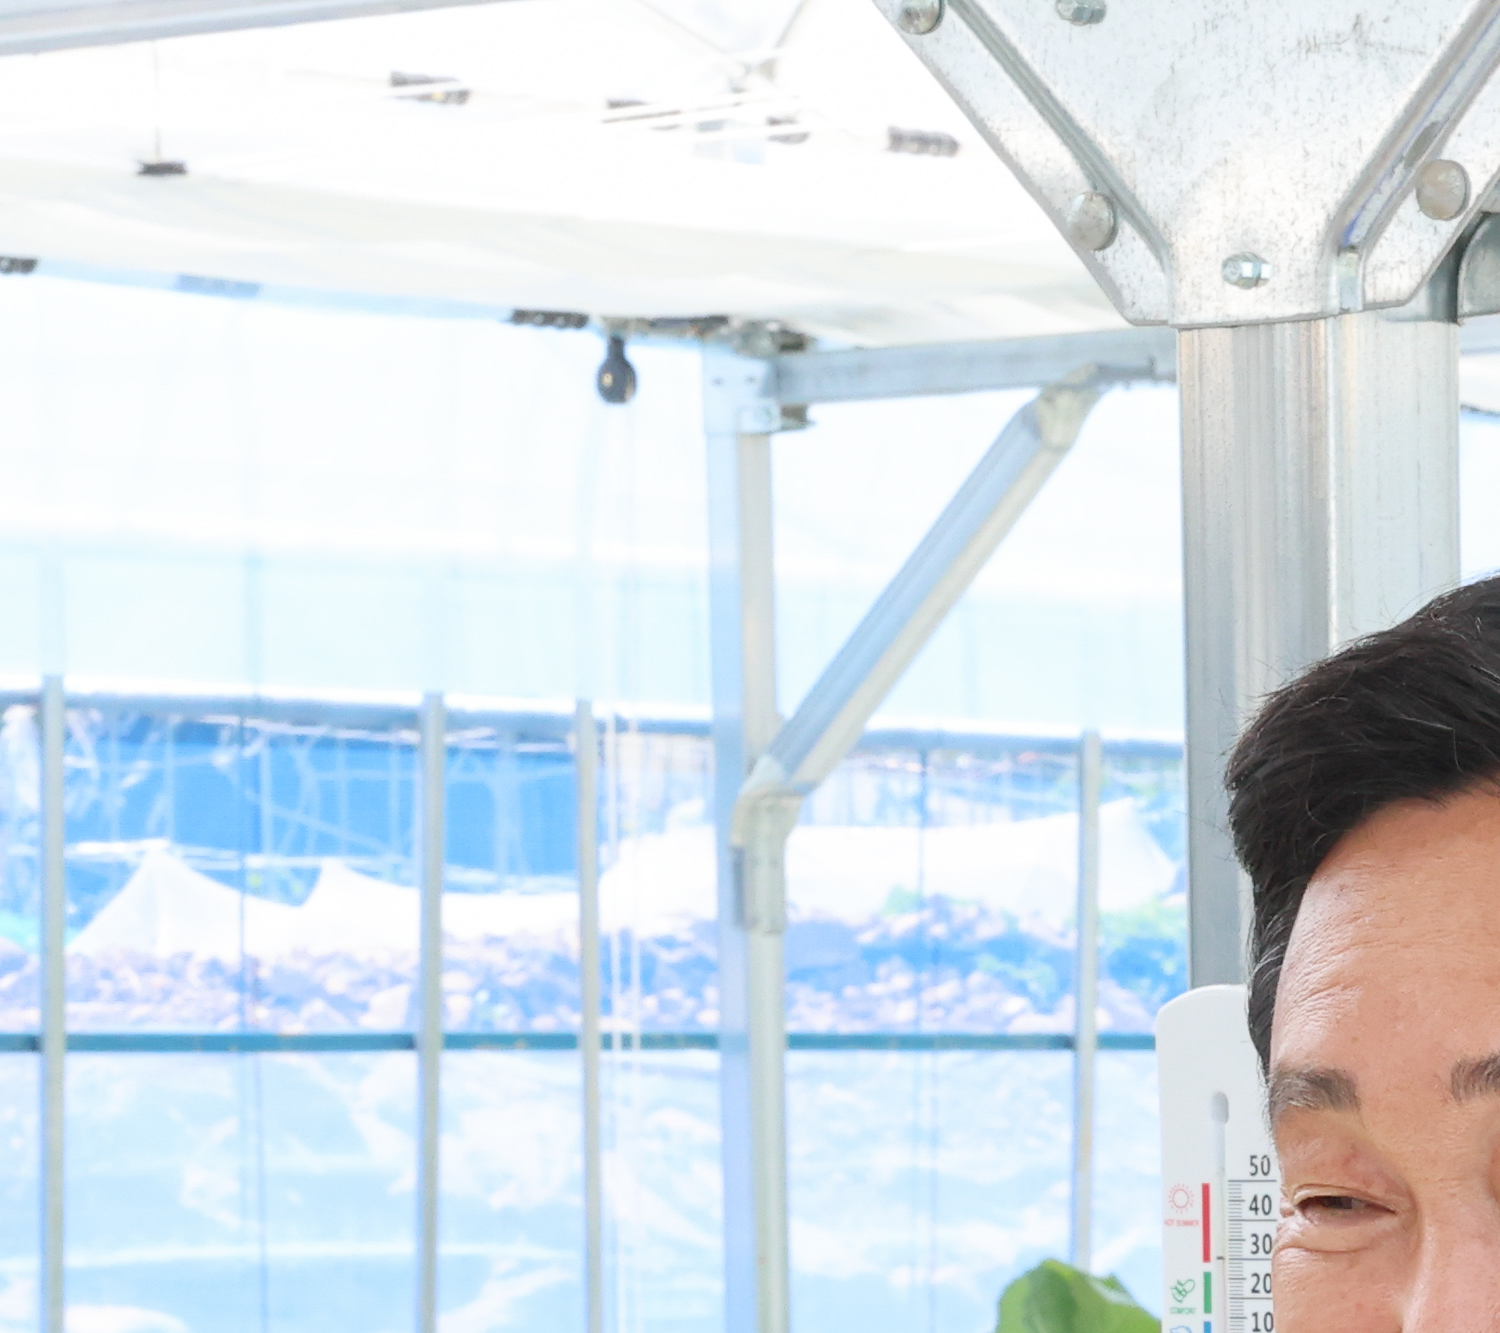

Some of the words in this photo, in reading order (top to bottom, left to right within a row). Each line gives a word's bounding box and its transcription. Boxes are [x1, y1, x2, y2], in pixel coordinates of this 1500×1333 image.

[1249, 1154, 1271, 1176] 50
[1249, 1194, 1272, 1216] 40
[1250, 1233, 1272, 1255] 30
[1251, 1273, 1272, 1294] 20
[1252, 1311, 1274, 1333] 10
